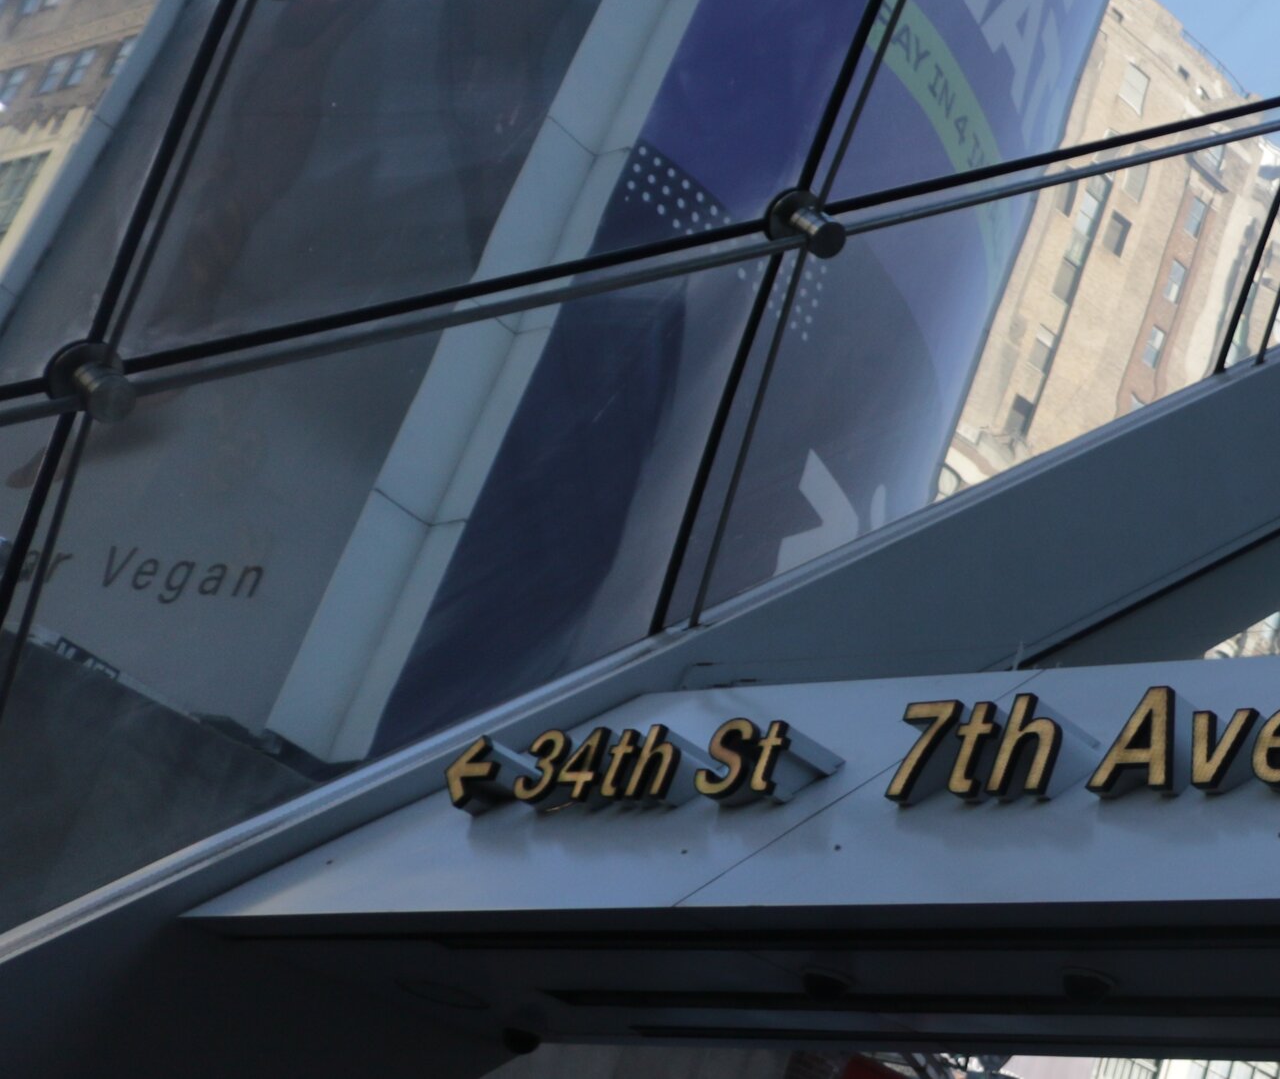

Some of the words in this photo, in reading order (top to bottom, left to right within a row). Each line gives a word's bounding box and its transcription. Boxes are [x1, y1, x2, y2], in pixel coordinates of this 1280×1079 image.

[101, 544, 266, 605] Vegan
[513, 724, 682, 806] 34th
[694, 715, 790, 805] St
[885, 692, 1063, 805] 7th
